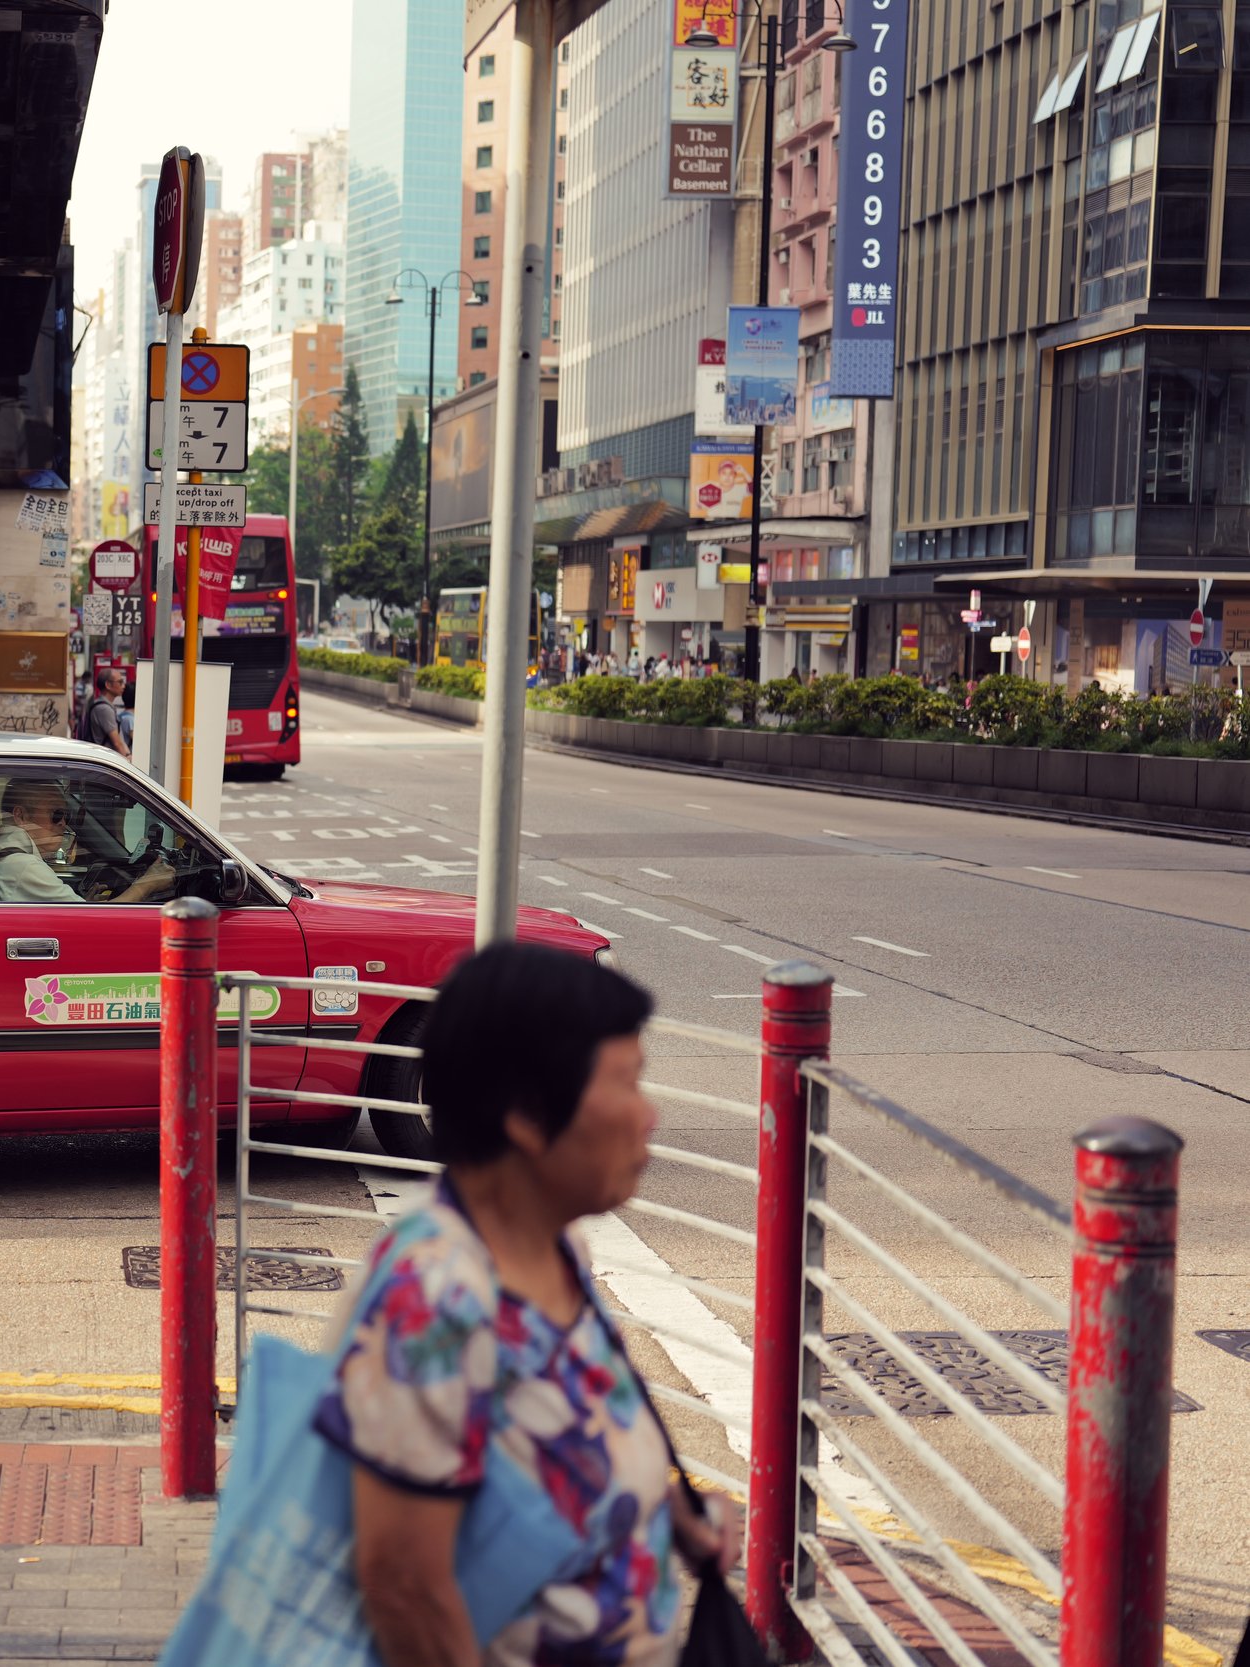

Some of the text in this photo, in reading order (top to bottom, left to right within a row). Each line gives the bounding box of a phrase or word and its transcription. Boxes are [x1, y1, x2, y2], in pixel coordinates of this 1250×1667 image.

[686, 127, 717, 141] The
[674, 144, 729, 158] Nathan
[679, 159, 723, 173] Cellar
[673, 177, 728, 191] Basement
[159, 188, 178, 228] STOP
[848, 282, 892, 300] 葉先生
[865, 310, 886, 325] JLL
[213, 406, 229, 428] 7
[212, 442, 228, 464] 7
[175, 488, 223, 498] xcept taxi
[220, 498, 235, 507] off
[149, 510, 240, 523] 的上落客除外
[117, 597, 141, 610] YT
[115, 611, 142, 625] 125
[116, 625, 132, 636] 26
